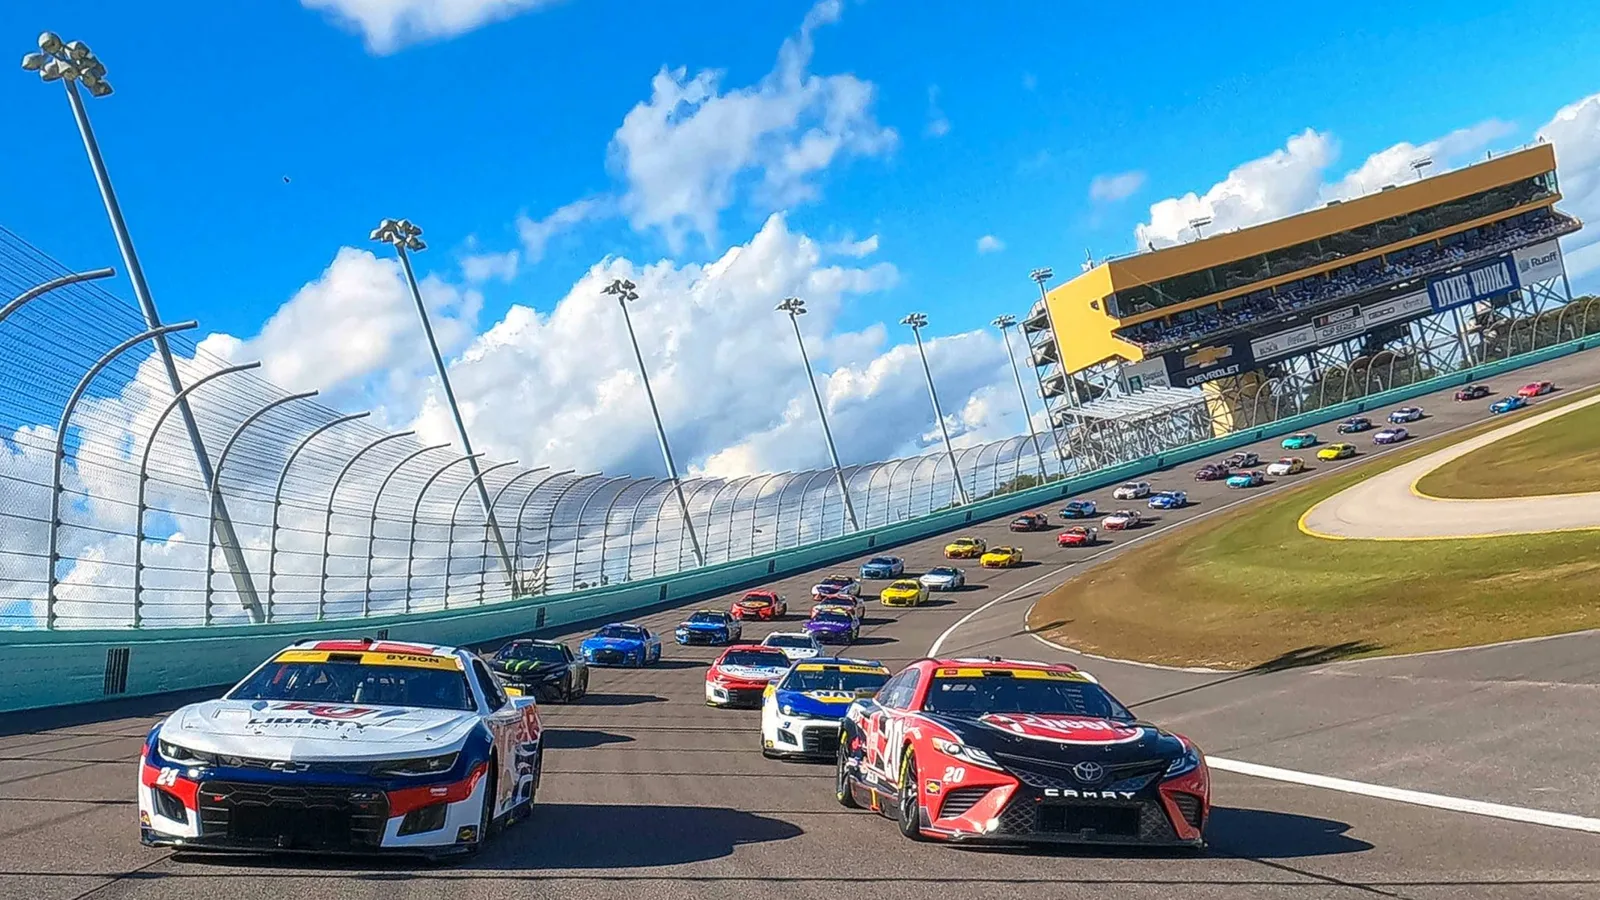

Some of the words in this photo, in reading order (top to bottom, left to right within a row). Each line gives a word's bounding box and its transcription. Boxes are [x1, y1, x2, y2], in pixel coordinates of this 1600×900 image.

[1530, 251, 1559, 268] Ruoff
[1433, 274, 1472, 308] DIXIE
[1469, 261, 1513, 296] VODKA
[1322, 327, 1336, 337] CUP
[1335, 319, 1358, 333] SERIES
[1186, 363, 1240, 386] CHEVROLET
[387, 654, 440, 665] BYRON
[248, 717, 369, 729] LIBERTY
[782, 721, 791, 729] 9
[884, 717, 904, 784] 20
[156, 766, 180, 787] 24
[942, 766, 966, 783] 20
[1044, 788, 1136, 800] CAMRY
